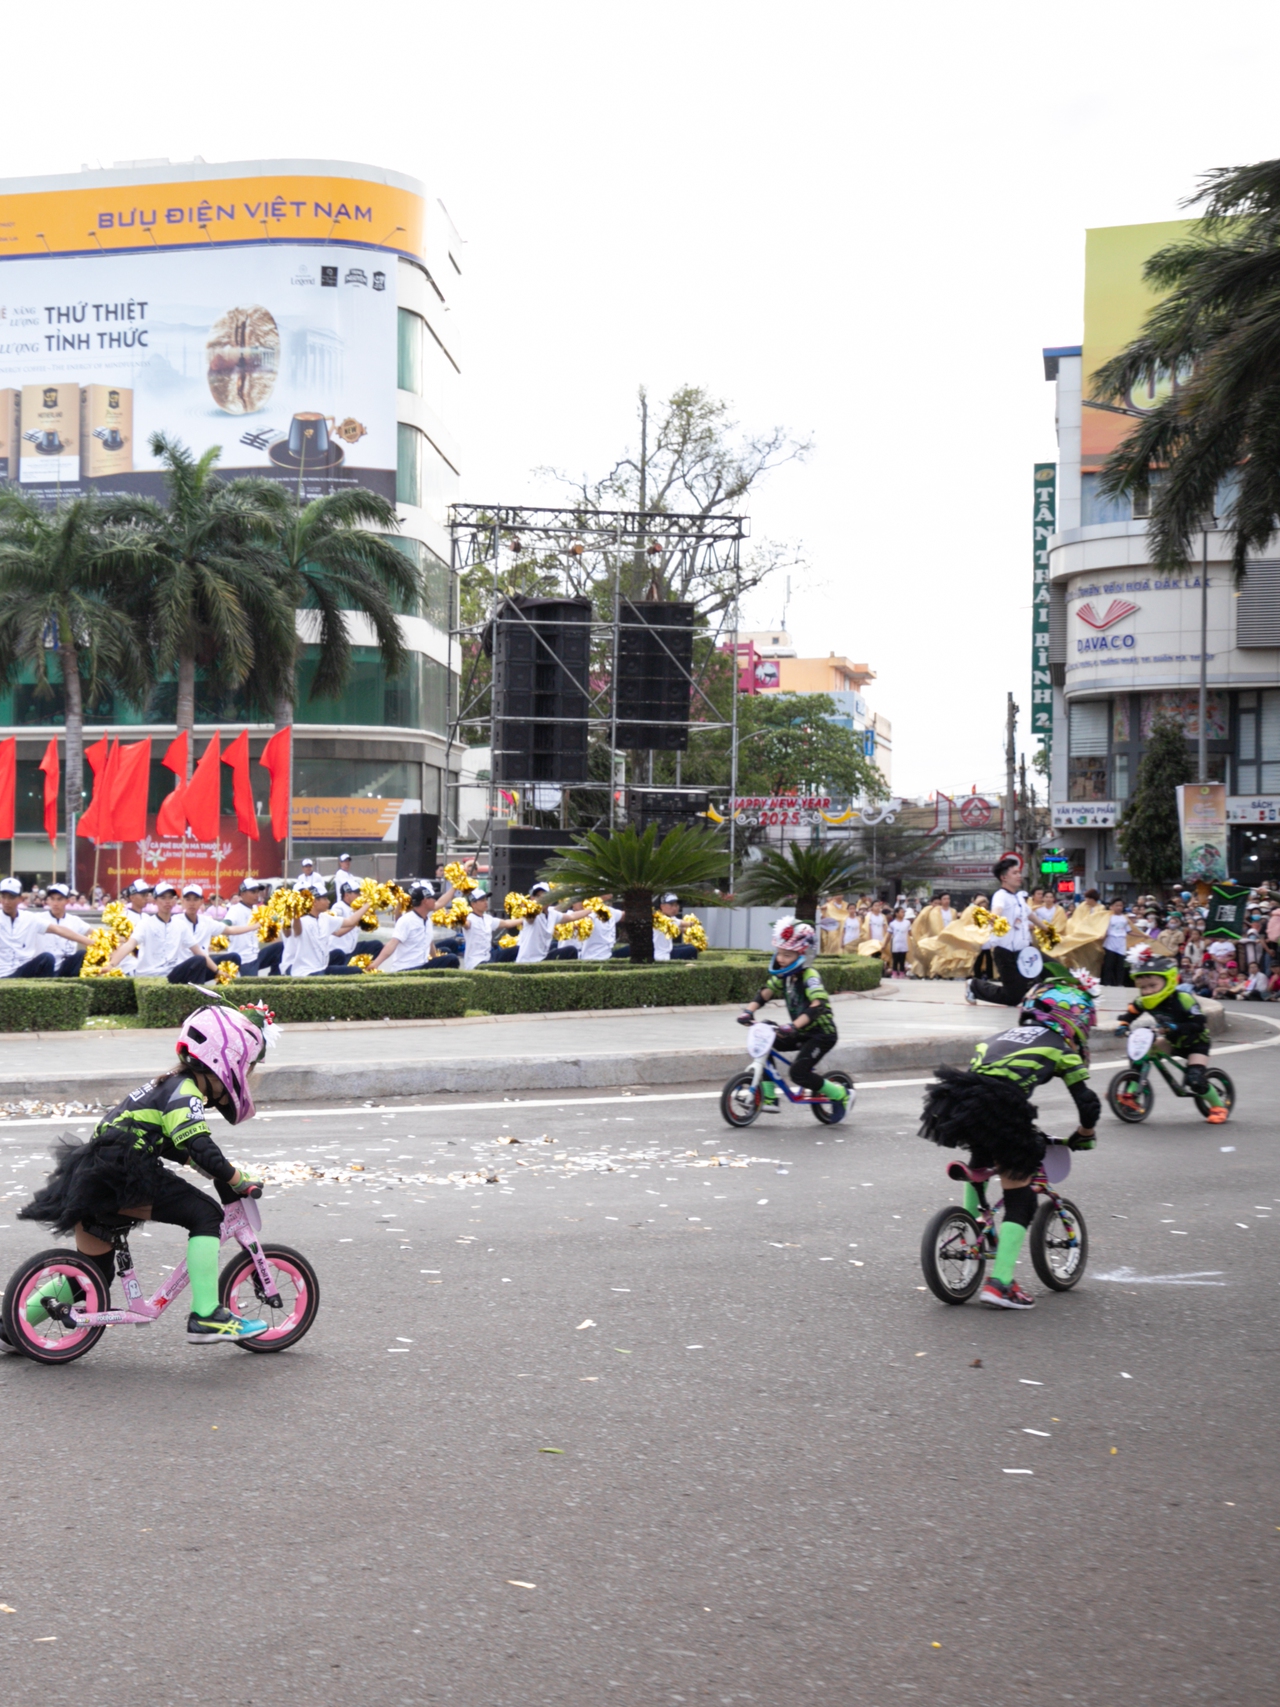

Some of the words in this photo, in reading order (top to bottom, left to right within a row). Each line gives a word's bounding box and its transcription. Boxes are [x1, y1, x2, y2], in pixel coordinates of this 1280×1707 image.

[98, 207, 157, 229] BƯU
[244, 195, 306, 222] VIỆT
[314, 202, 372, 222] NAM
[44, 300, 88, 325] THỨ
[92, 297, 149, 324] THIỆT
[96, 326, 149, 349] THỨC
[0, 342, 40, 356] LƯỢNG
[344, 426, 357, 434] NEW
[1034, 486, 1055, 540] TÂN
[1077, 634, 1135, 653] DAVACO
[1033, 632, 1052, 704] BÌNH
[1035, 712, 1051, 727] 2
[728, 797, 767, 809] HAPPY
[769, 797, 798, 809] NEW
[801, 797, 831, 809] YEAR
[1251, 799, 1273, 809] SÁCH
[760, 811, 800, 826] 2025
